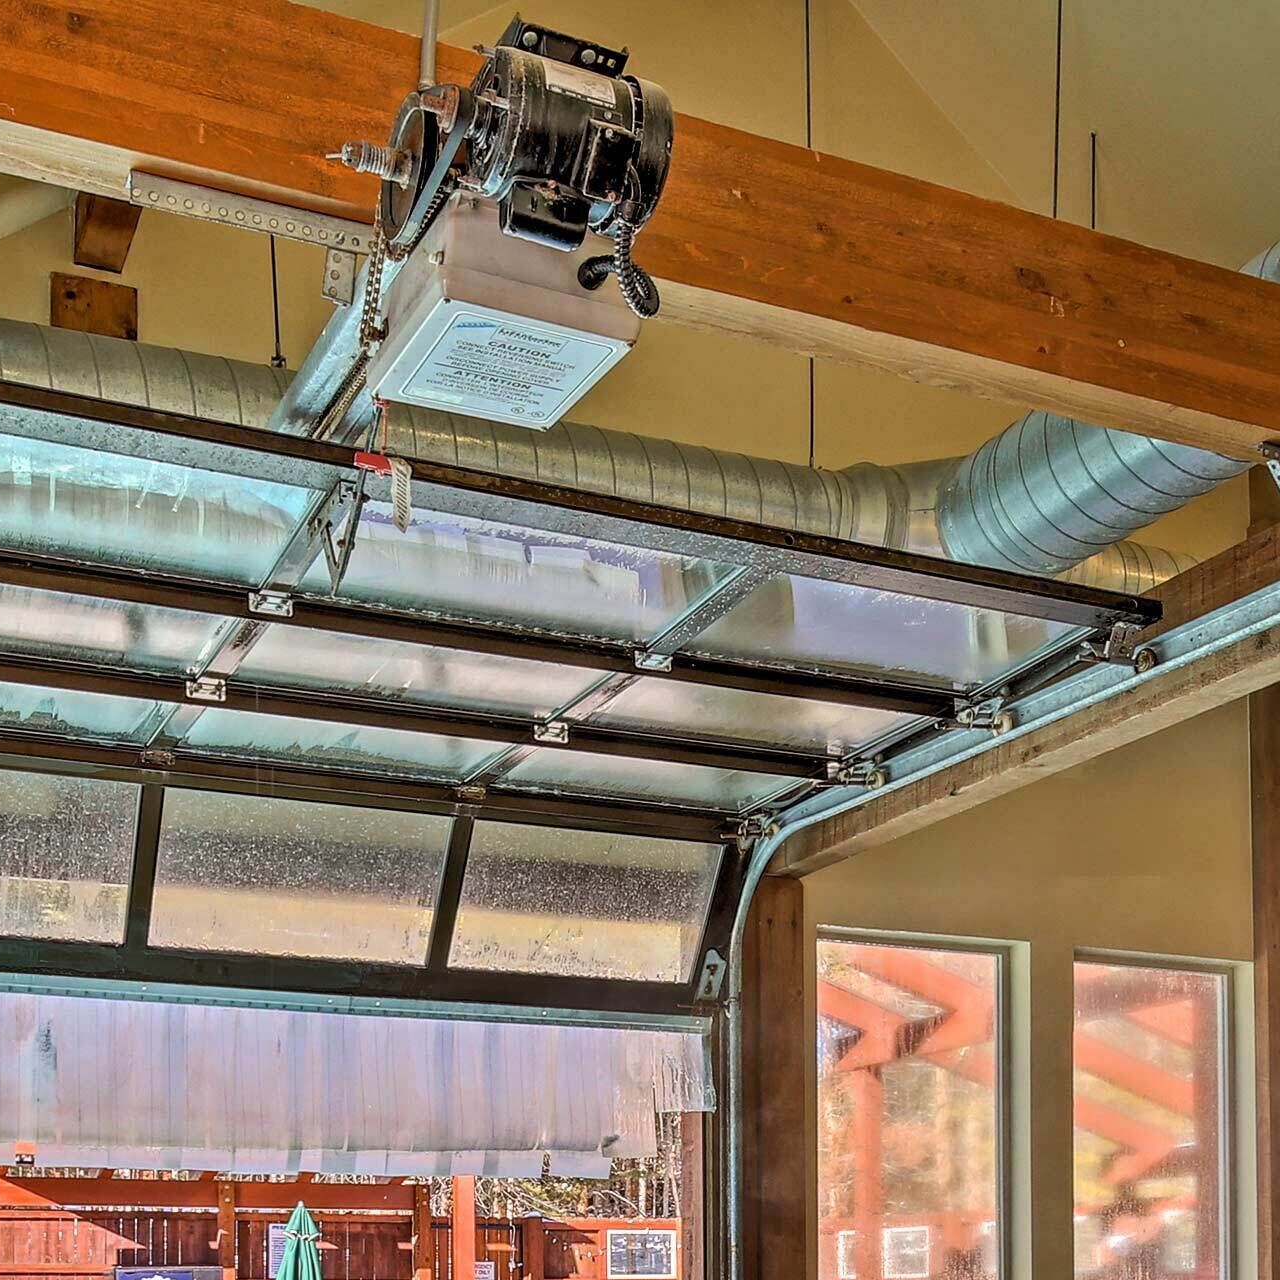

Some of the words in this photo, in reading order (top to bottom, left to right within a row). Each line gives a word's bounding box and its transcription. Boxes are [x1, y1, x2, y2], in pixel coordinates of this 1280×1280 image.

[455, 339, 496, 351] CONNECT
[487, 340, 551, 358] CAUTION
[445, 355, 498, 369] DISCONNECT
[497, 366, 529, 376] POWER
[528, 373, 560, 383] SUPPLY
[474, 348, 533, 364] INSTALLATION
[533, 362, 566, 372] MANUAL
[450, 360, 482, 370] BEFORE
[483, 368, 521, 379] OPENING
[520, 376, 550, 385] COVER
[453, 369, 531, 389] ATTENTION
